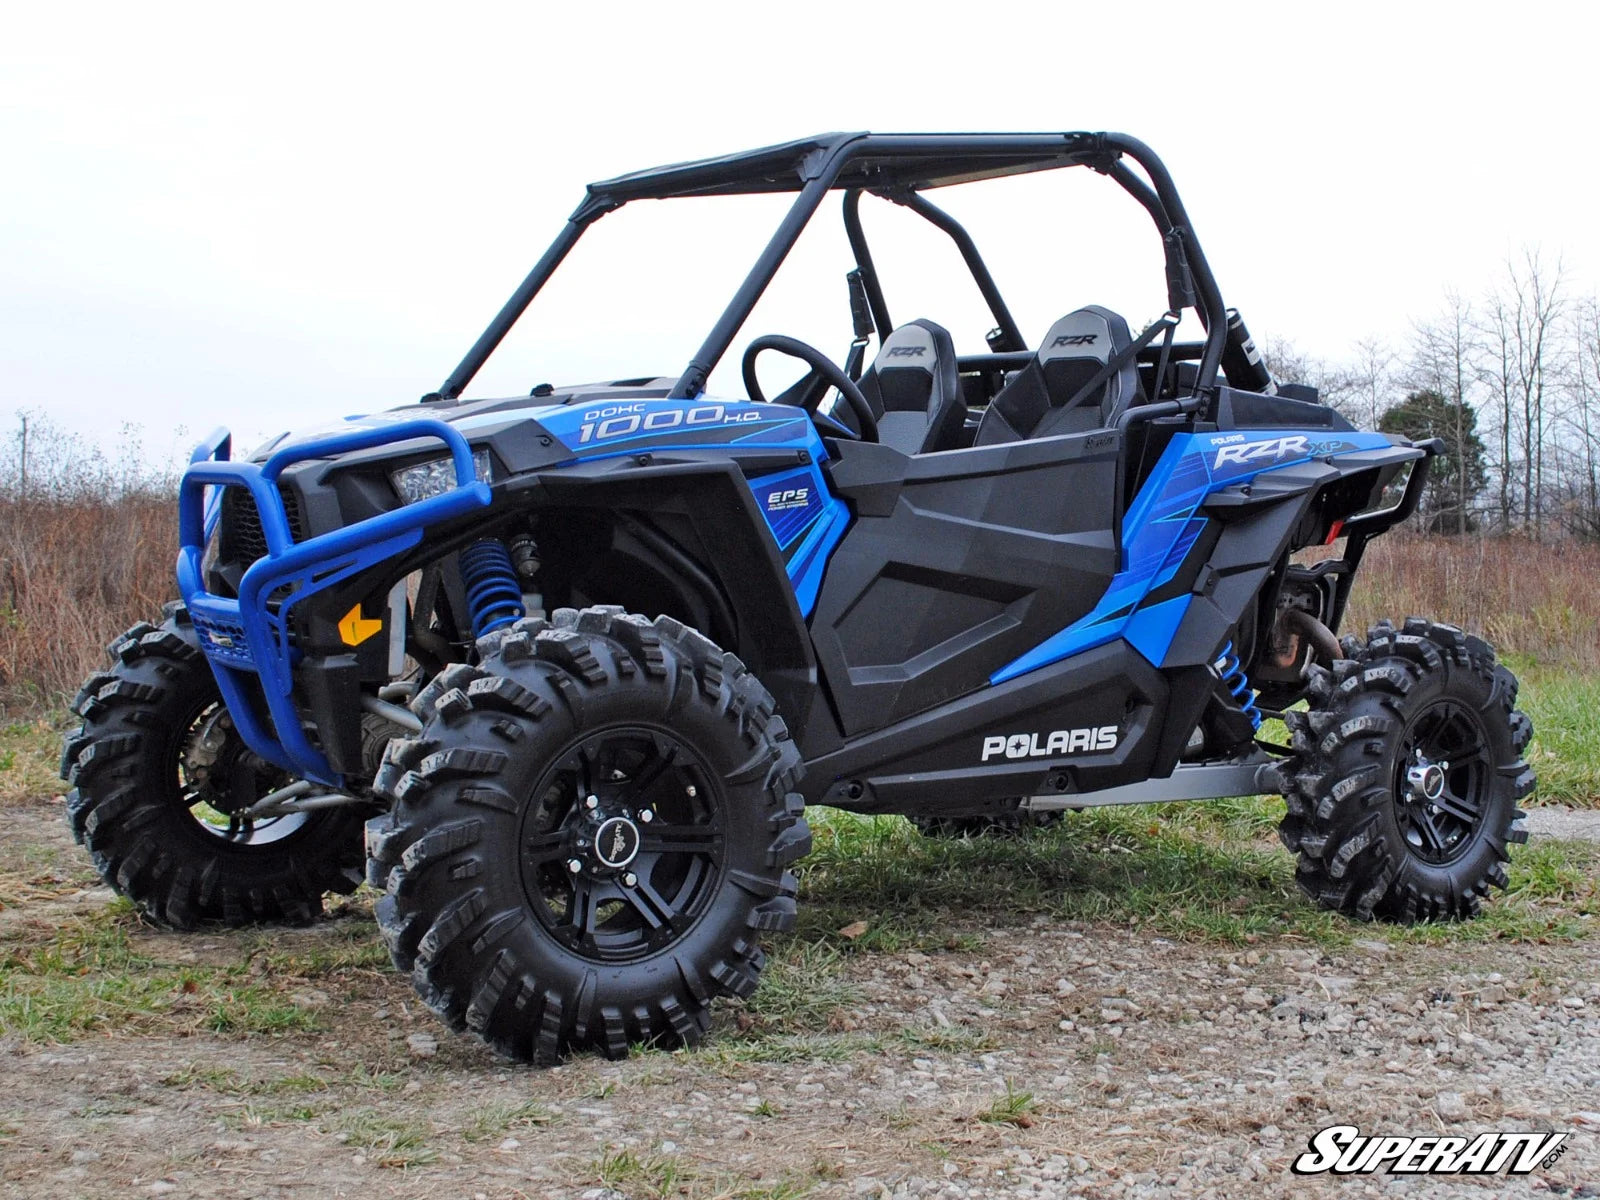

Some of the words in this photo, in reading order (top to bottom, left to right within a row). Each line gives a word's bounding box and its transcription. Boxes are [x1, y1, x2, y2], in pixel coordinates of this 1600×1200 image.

[1050, 334, 1098, 348] RZR
[886, 346, 927, 358] RZR
[584, 403, 647, 421] DOHC
[578, 404, 726, 443] 1000
[1210, 434, 1246, 445] POLARIS
[1212, 435, 1309, 471] RZR
[1307, 440, 1343, 456] XP
[767, 487, 809, 504] EPS
[981, 725, 1119, 762] POLARIS
